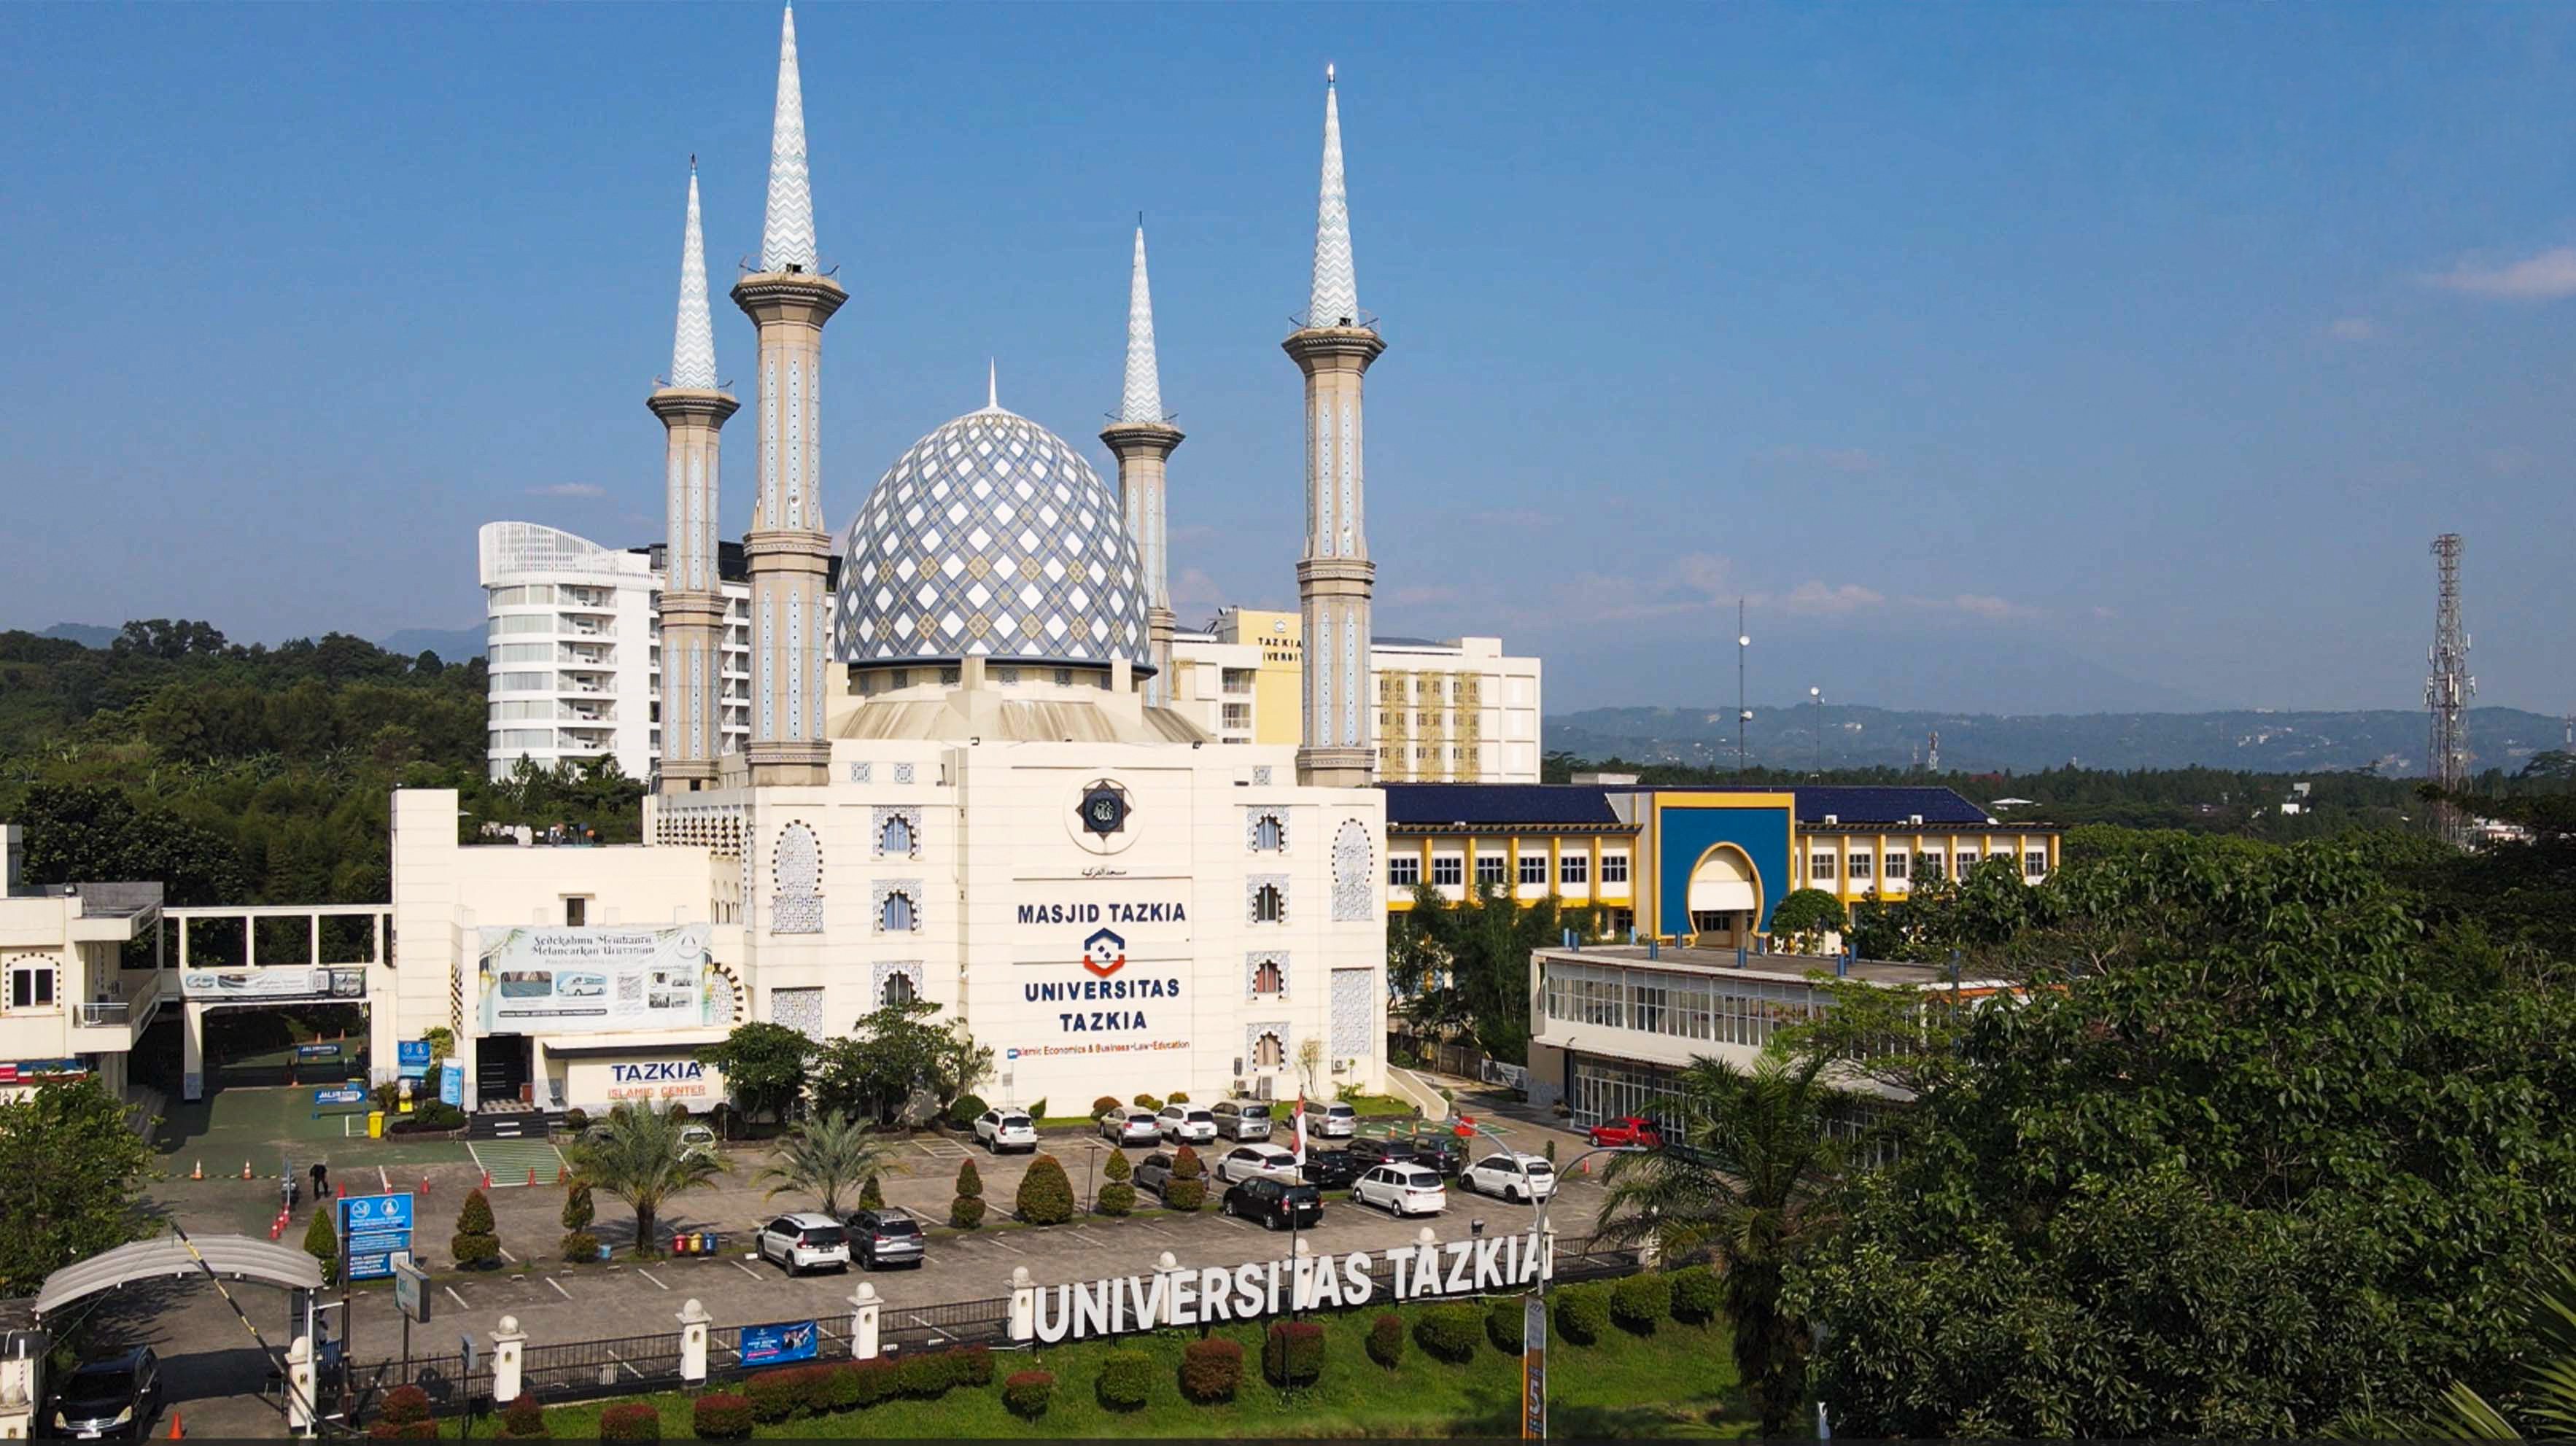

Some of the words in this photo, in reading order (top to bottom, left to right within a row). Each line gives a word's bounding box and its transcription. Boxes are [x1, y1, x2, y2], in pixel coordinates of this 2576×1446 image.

[1258, 637, 1302, 648] TAZKIA
[1017, 903, 1100, 924] MASJID
[1109, 903, 1186, 922] TAZKIA
[1025, 979, 1180, 1003] UNIVERSITAS
[1060, 1011, 1147, 1032] TAZKIA
[1044, 1045, 1086, 1056] Economics
[1088, 1044, 1093, 1054] &
[611, 1062, 702, 1082] TAZKIA
[608, 1087, 654, 1099] ISLAMIC
[661, 1084, 706, 1097] CENTER
[1035, 1252, 1373, 1343] UNIVERSITAS
[1387, 1233, 1550, 1299] TAZKIA
